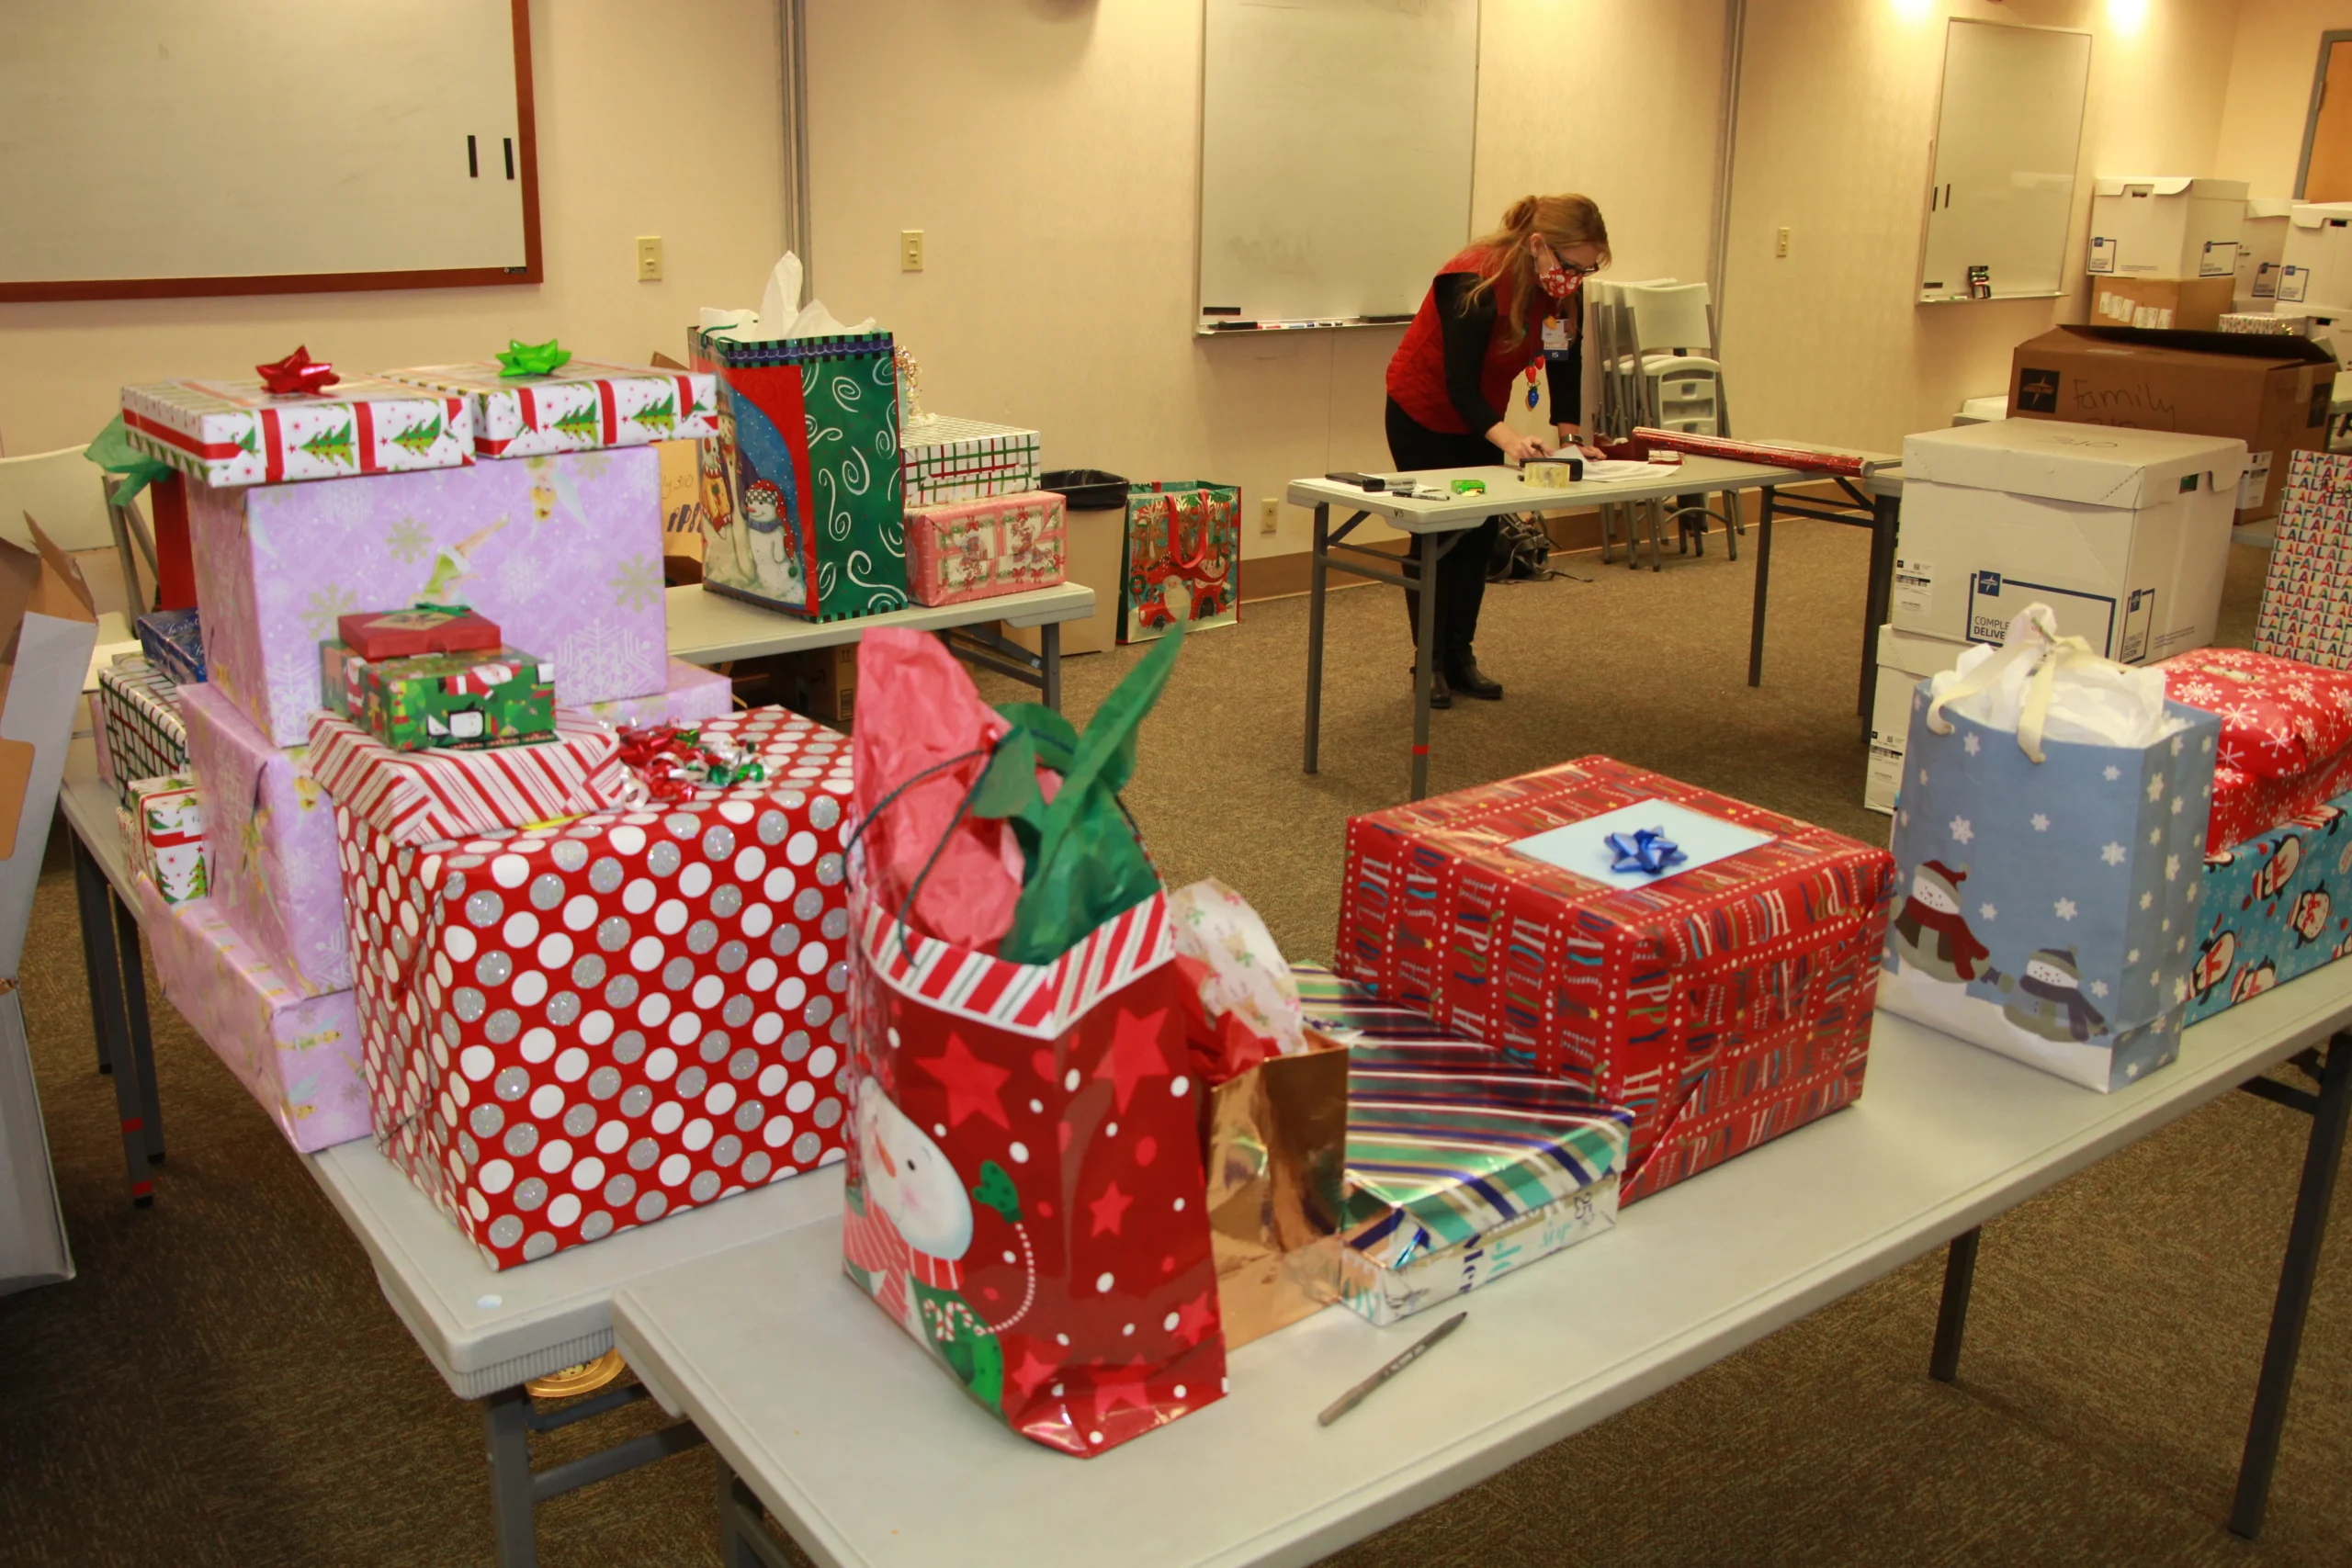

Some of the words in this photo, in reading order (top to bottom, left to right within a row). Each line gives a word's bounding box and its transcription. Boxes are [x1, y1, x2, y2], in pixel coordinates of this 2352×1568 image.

[2073, 378, 2176, 432] Family
[674, 474, 694, 490] 310
[1973, 626, 2006, 640] DELIVE
[1974, 615, 2010, 631] COMPLE
[1352, 854, 1395, 998] HOLIDAY
[1500, 916, 1551, 1068] HOLIDAY
